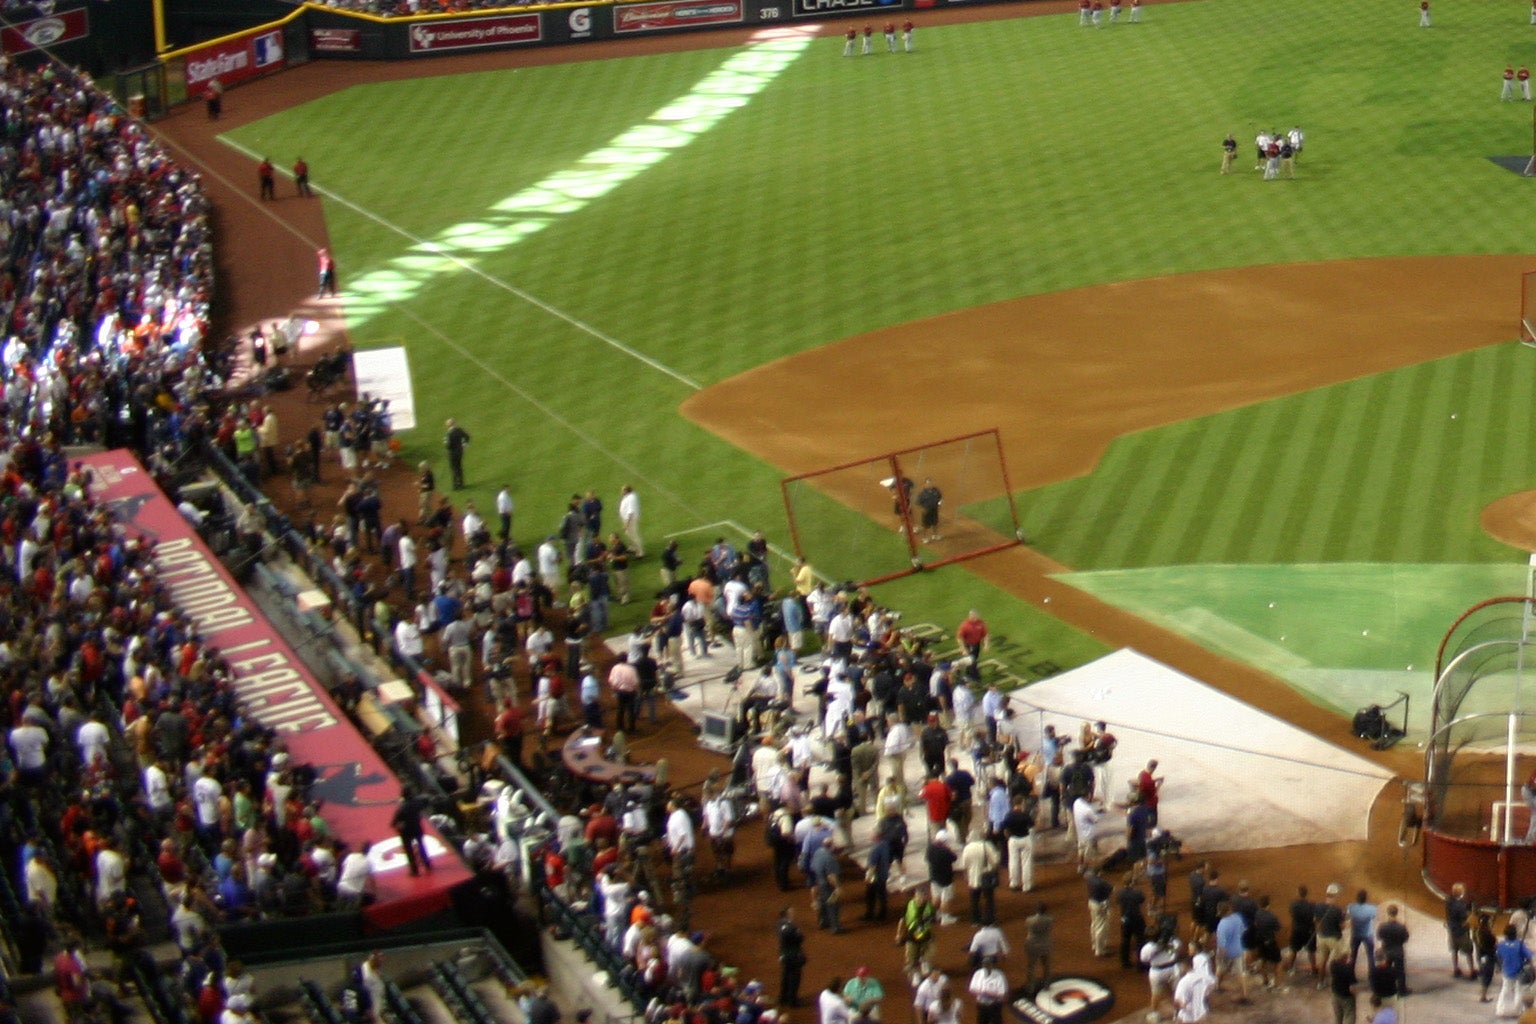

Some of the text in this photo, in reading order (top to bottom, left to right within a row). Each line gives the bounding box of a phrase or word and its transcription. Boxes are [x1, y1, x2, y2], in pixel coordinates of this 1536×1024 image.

[568, 9, 590, 32] G
[437, 24, 536, 42] University of Phoenix
